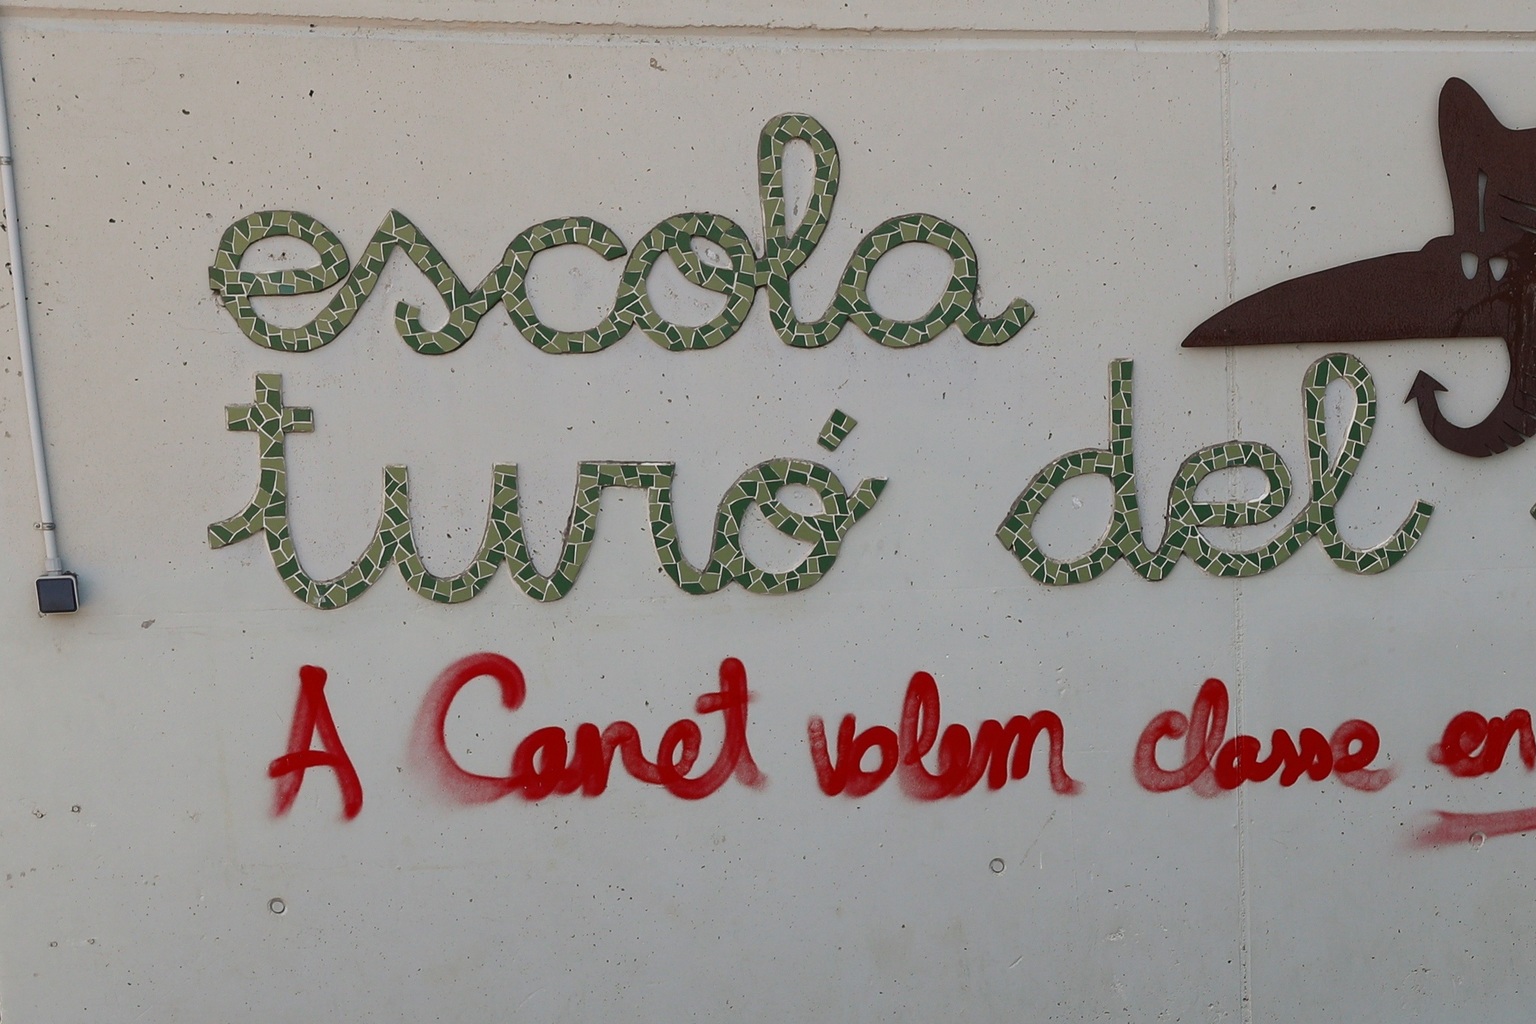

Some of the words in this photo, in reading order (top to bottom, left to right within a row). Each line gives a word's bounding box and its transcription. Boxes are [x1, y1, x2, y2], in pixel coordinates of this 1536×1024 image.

[208, 112, 1034, 355] escola
[207, 373, 888, 610] turó
[995, 353, 1435, 585] del
[268, 664, 364, 822] A
[408, 652, 768, 804] Canet
[808, 671, 1084, 802] volem
[1133, 678, 1396, 797] classe
